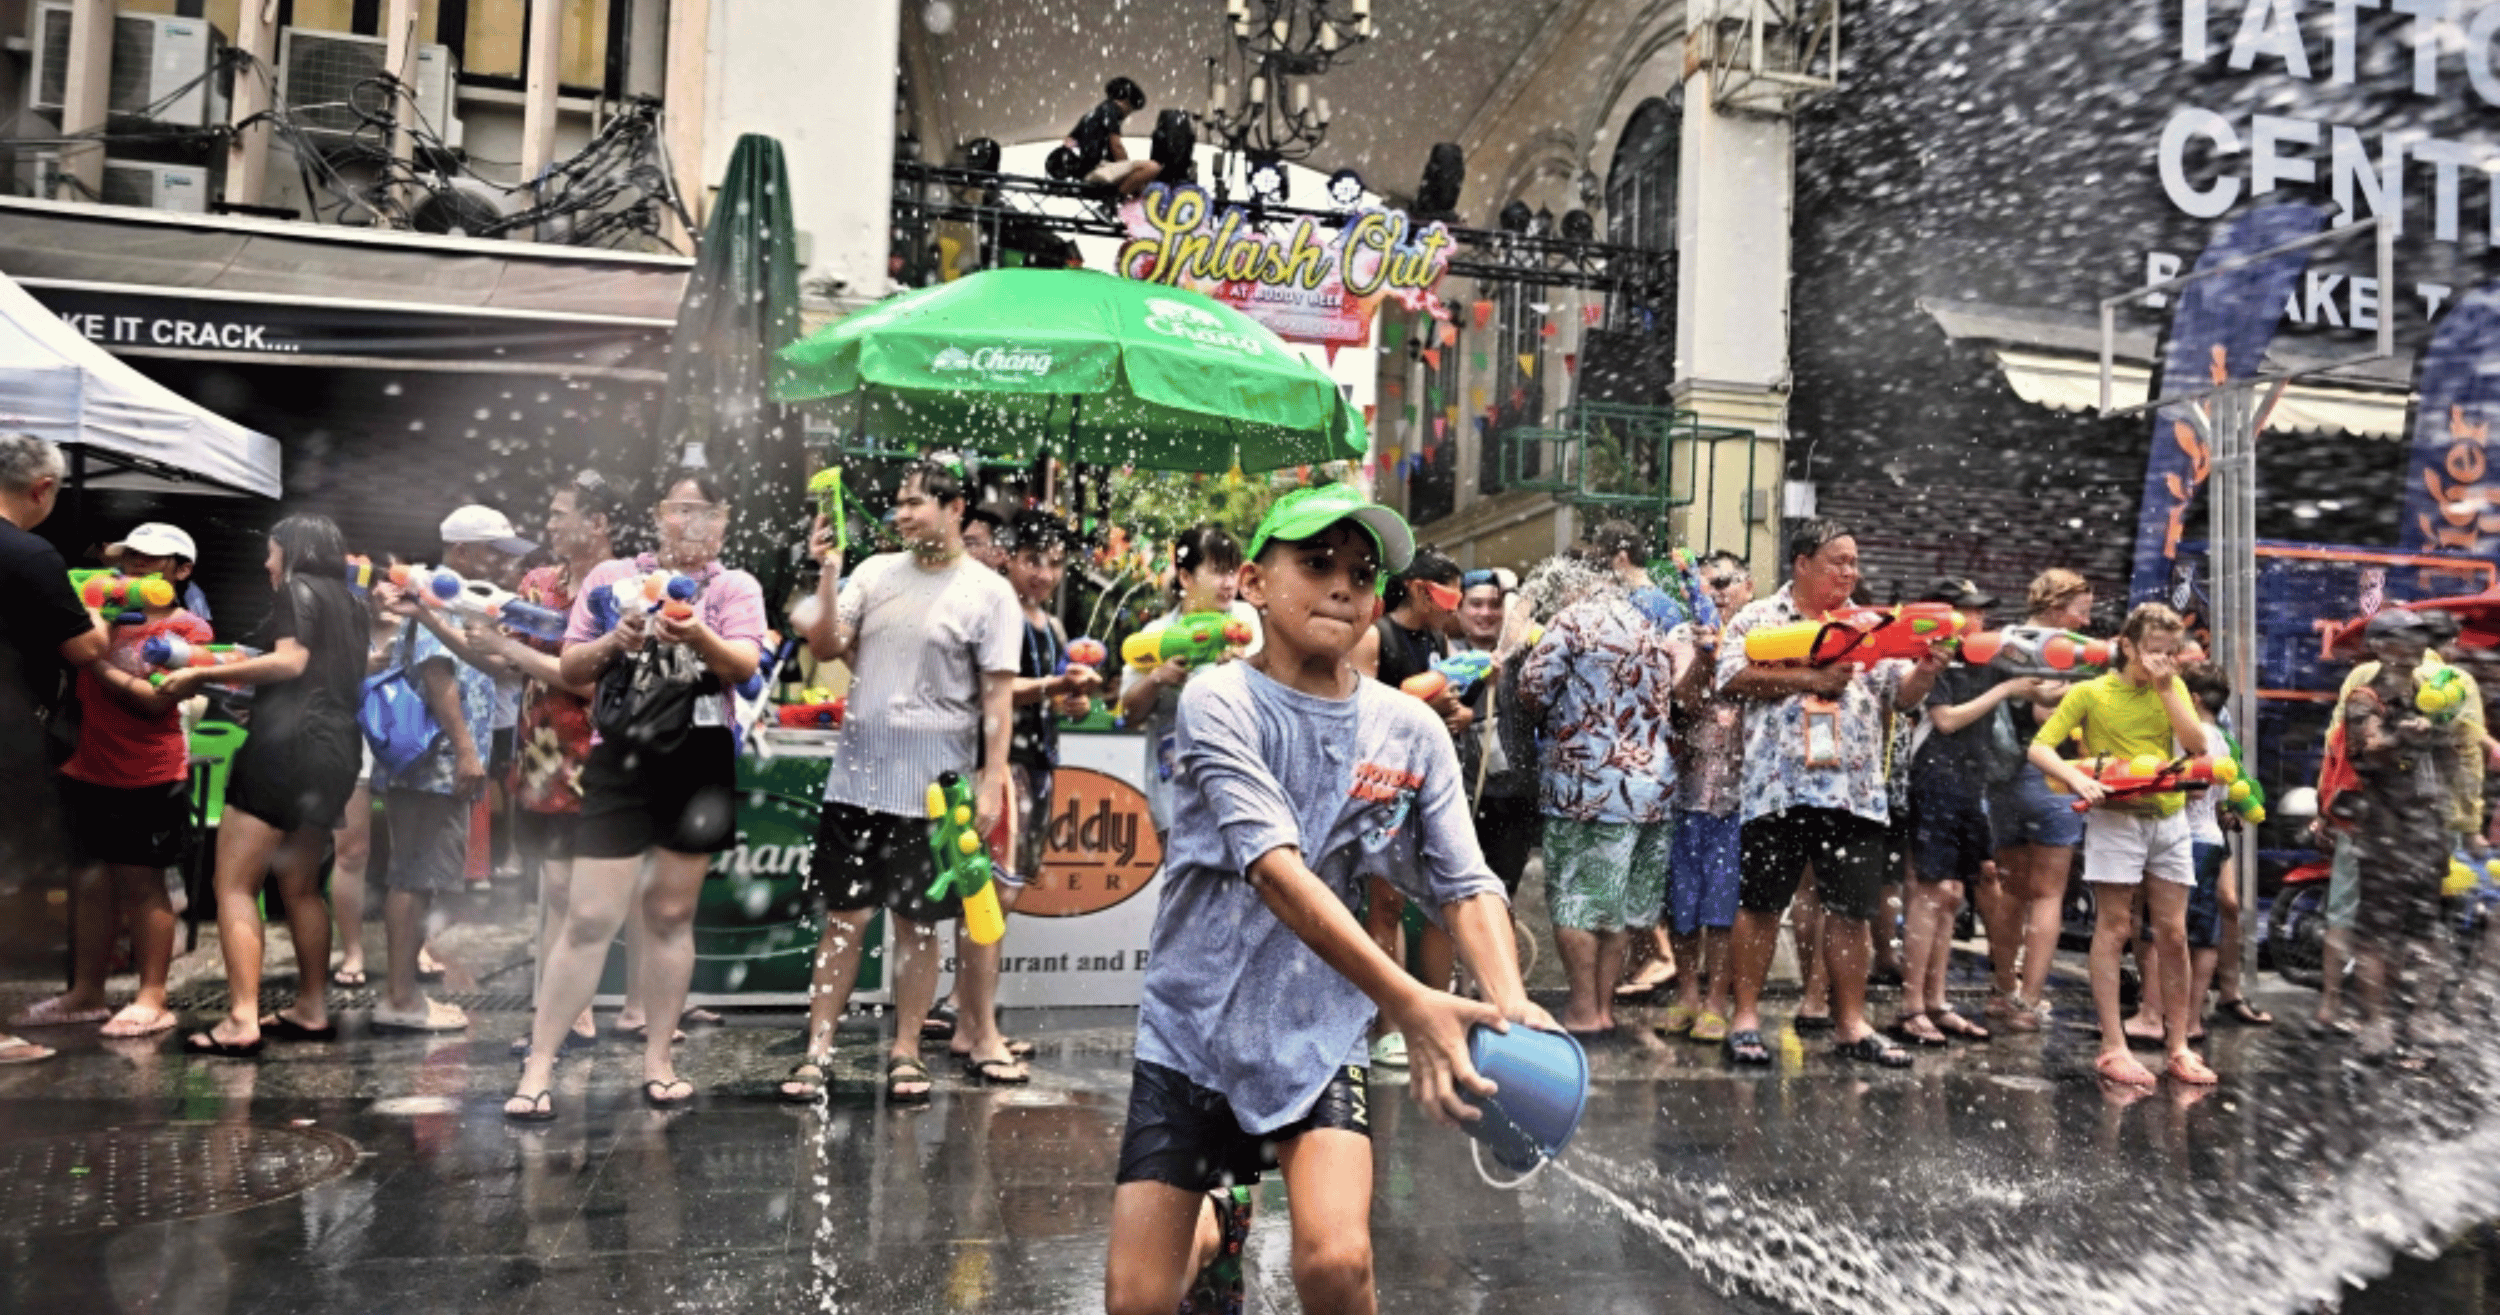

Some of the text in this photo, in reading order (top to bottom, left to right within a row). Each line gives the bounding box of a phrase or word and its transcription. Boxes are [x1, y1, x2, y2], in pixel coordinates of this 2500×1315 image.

[2157, 106, 2500, 247] CENT
[1118, 190, 1447, 297] Splash Out
[2284, 269, 2379, 331] KE
[62, 311, 106, 340] KE
[114, 316, 144, 342] IT
[1144, 316, 1263, 355] Chang
[971, 347, 1053, 376] Chang
[710, 831, 811, 876] han
[1050, 798, 1138, 868] ddy
[938, 952, 1069, 975] eurant
[1077, 950, 1126, 973] and
[1347, 1066, 1368, 1126] NAB
